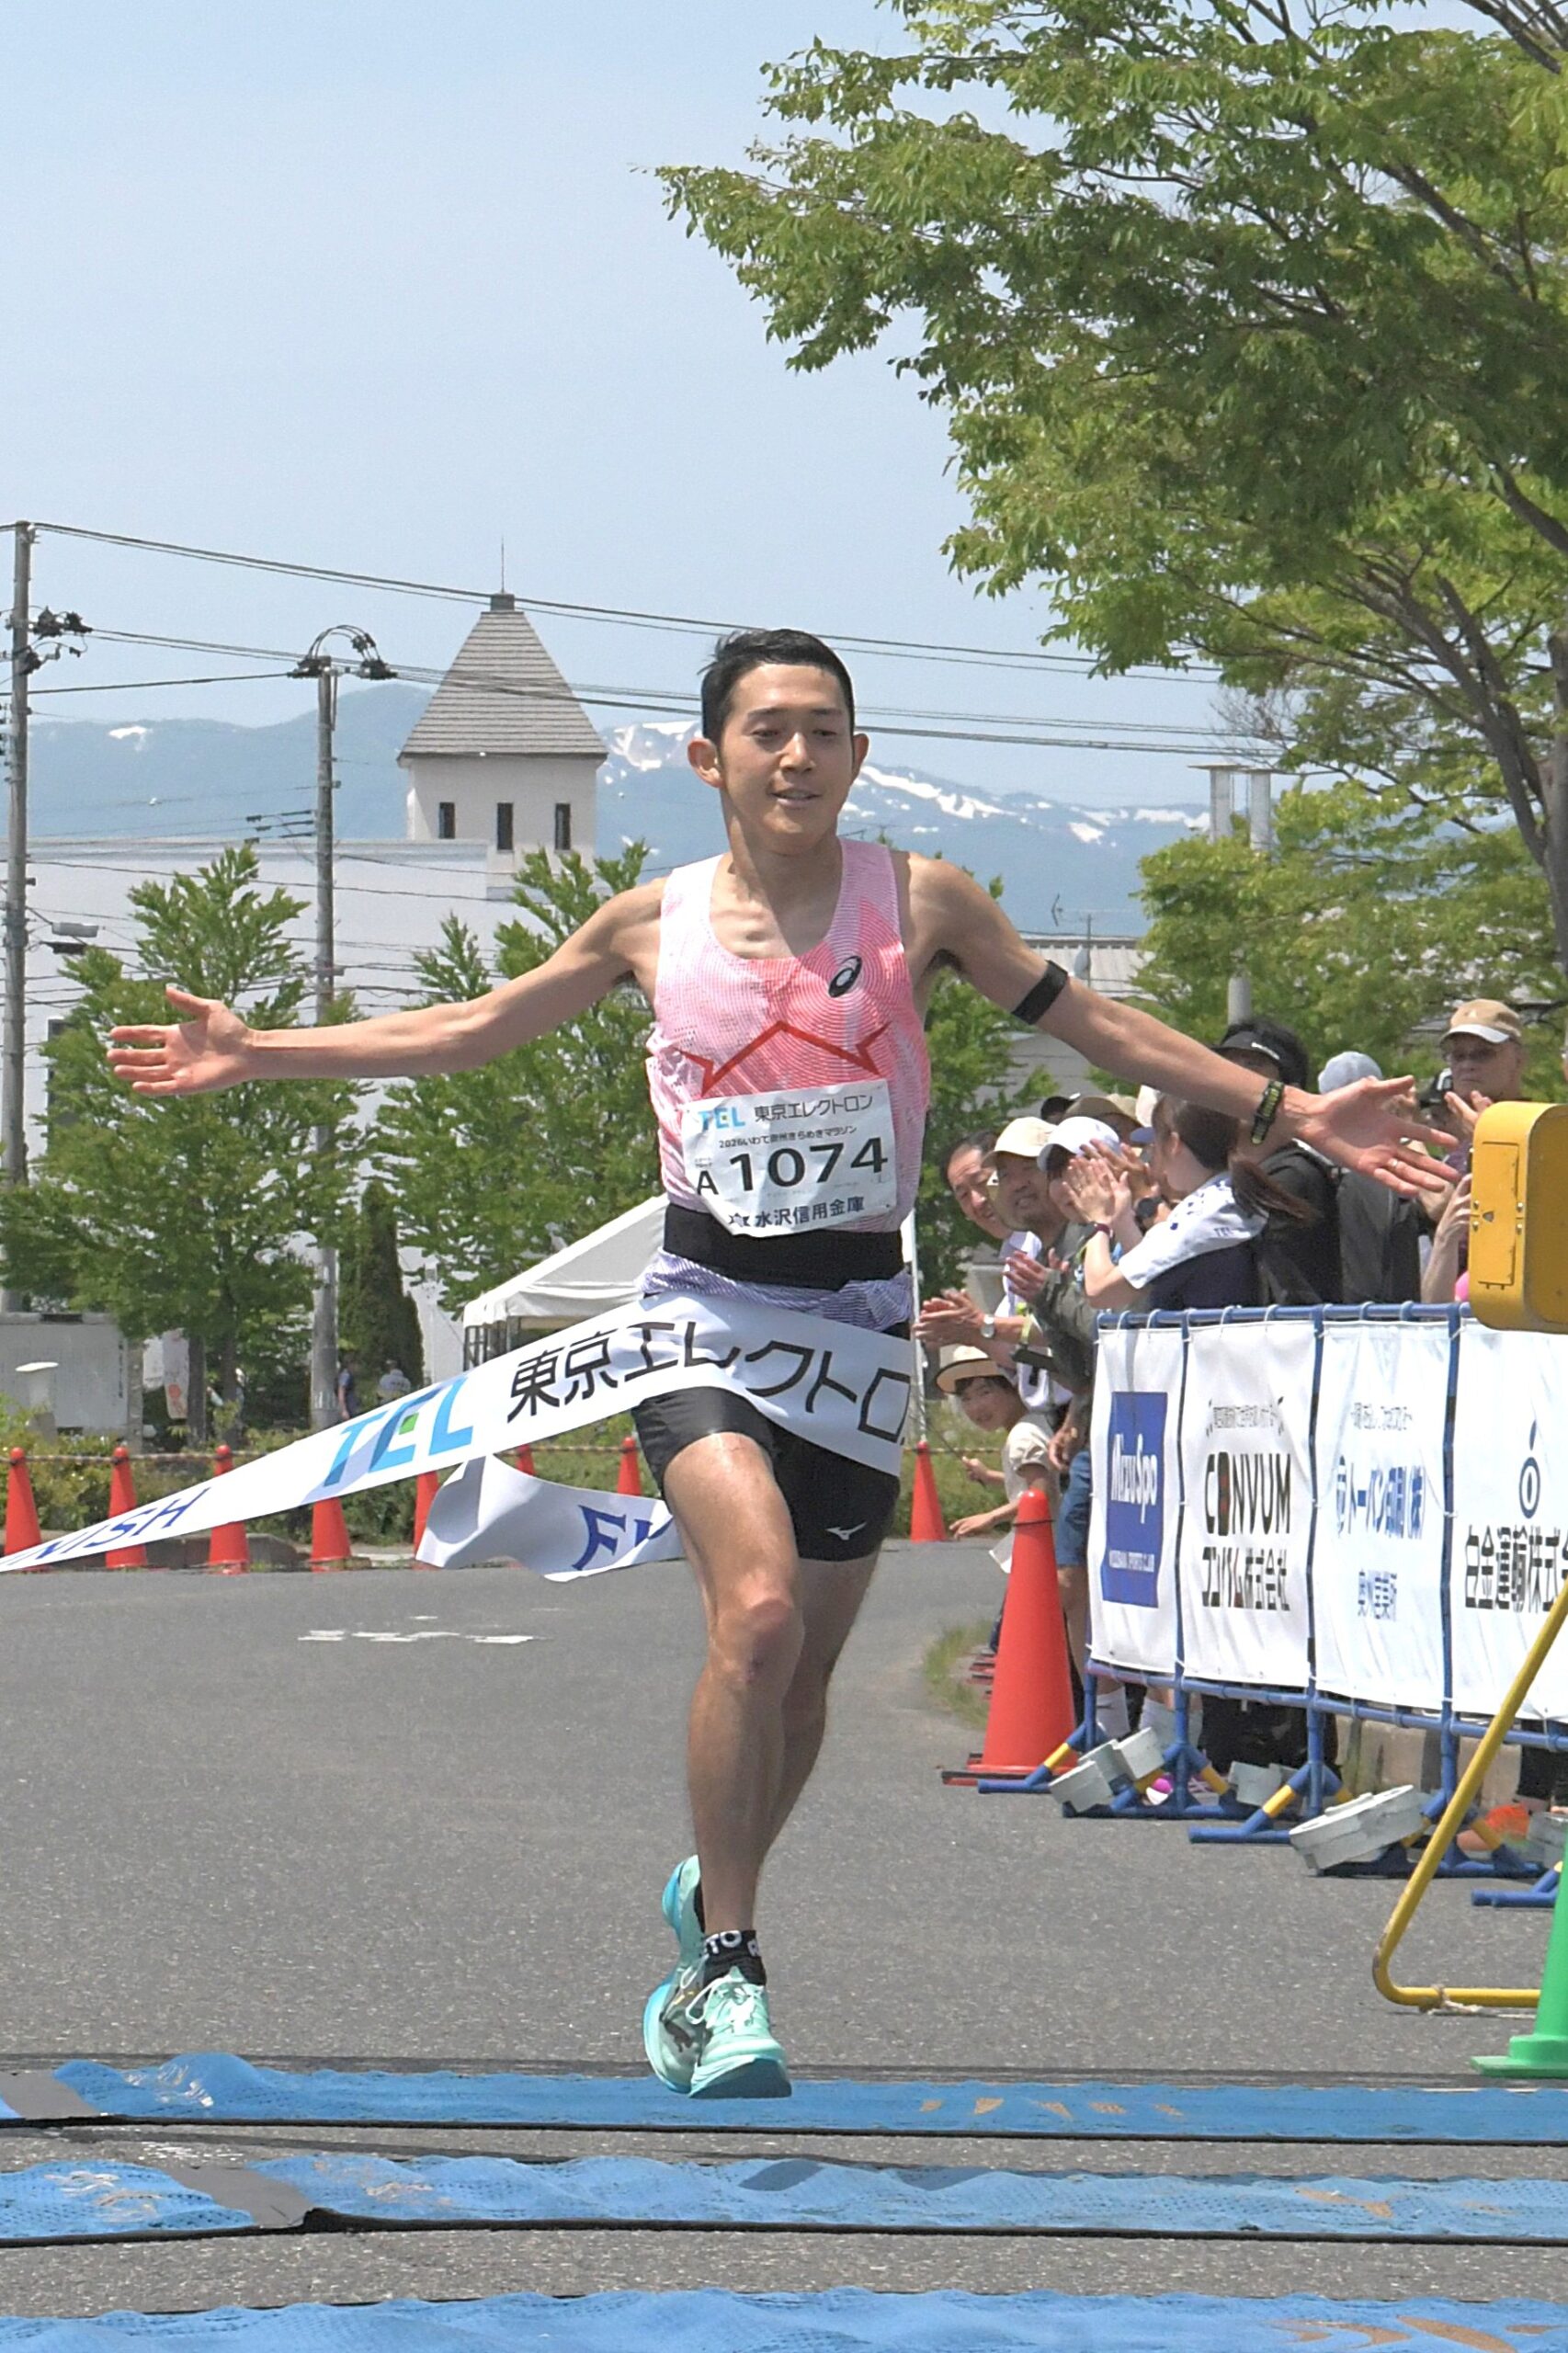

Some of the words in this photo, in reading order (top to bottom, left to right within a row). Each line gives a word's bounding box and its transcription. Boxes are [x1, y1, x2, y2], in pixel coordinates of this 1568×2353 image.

[698, 1108, 745, 1131] TEL
[755, 1095, 873, 1122] 東京エレクトロン
[697, 1170, 719, 1195] A
[730, 1137, 888, 1192] 1074
[755, 1196, 865, 1228] 水沢信用金庫
[323, 1376, 474, 1487] TEL
[507, 1321, 911, 1446] 東京エレクトロ
[1205, 1451, 1291, 1537] CONVUM
